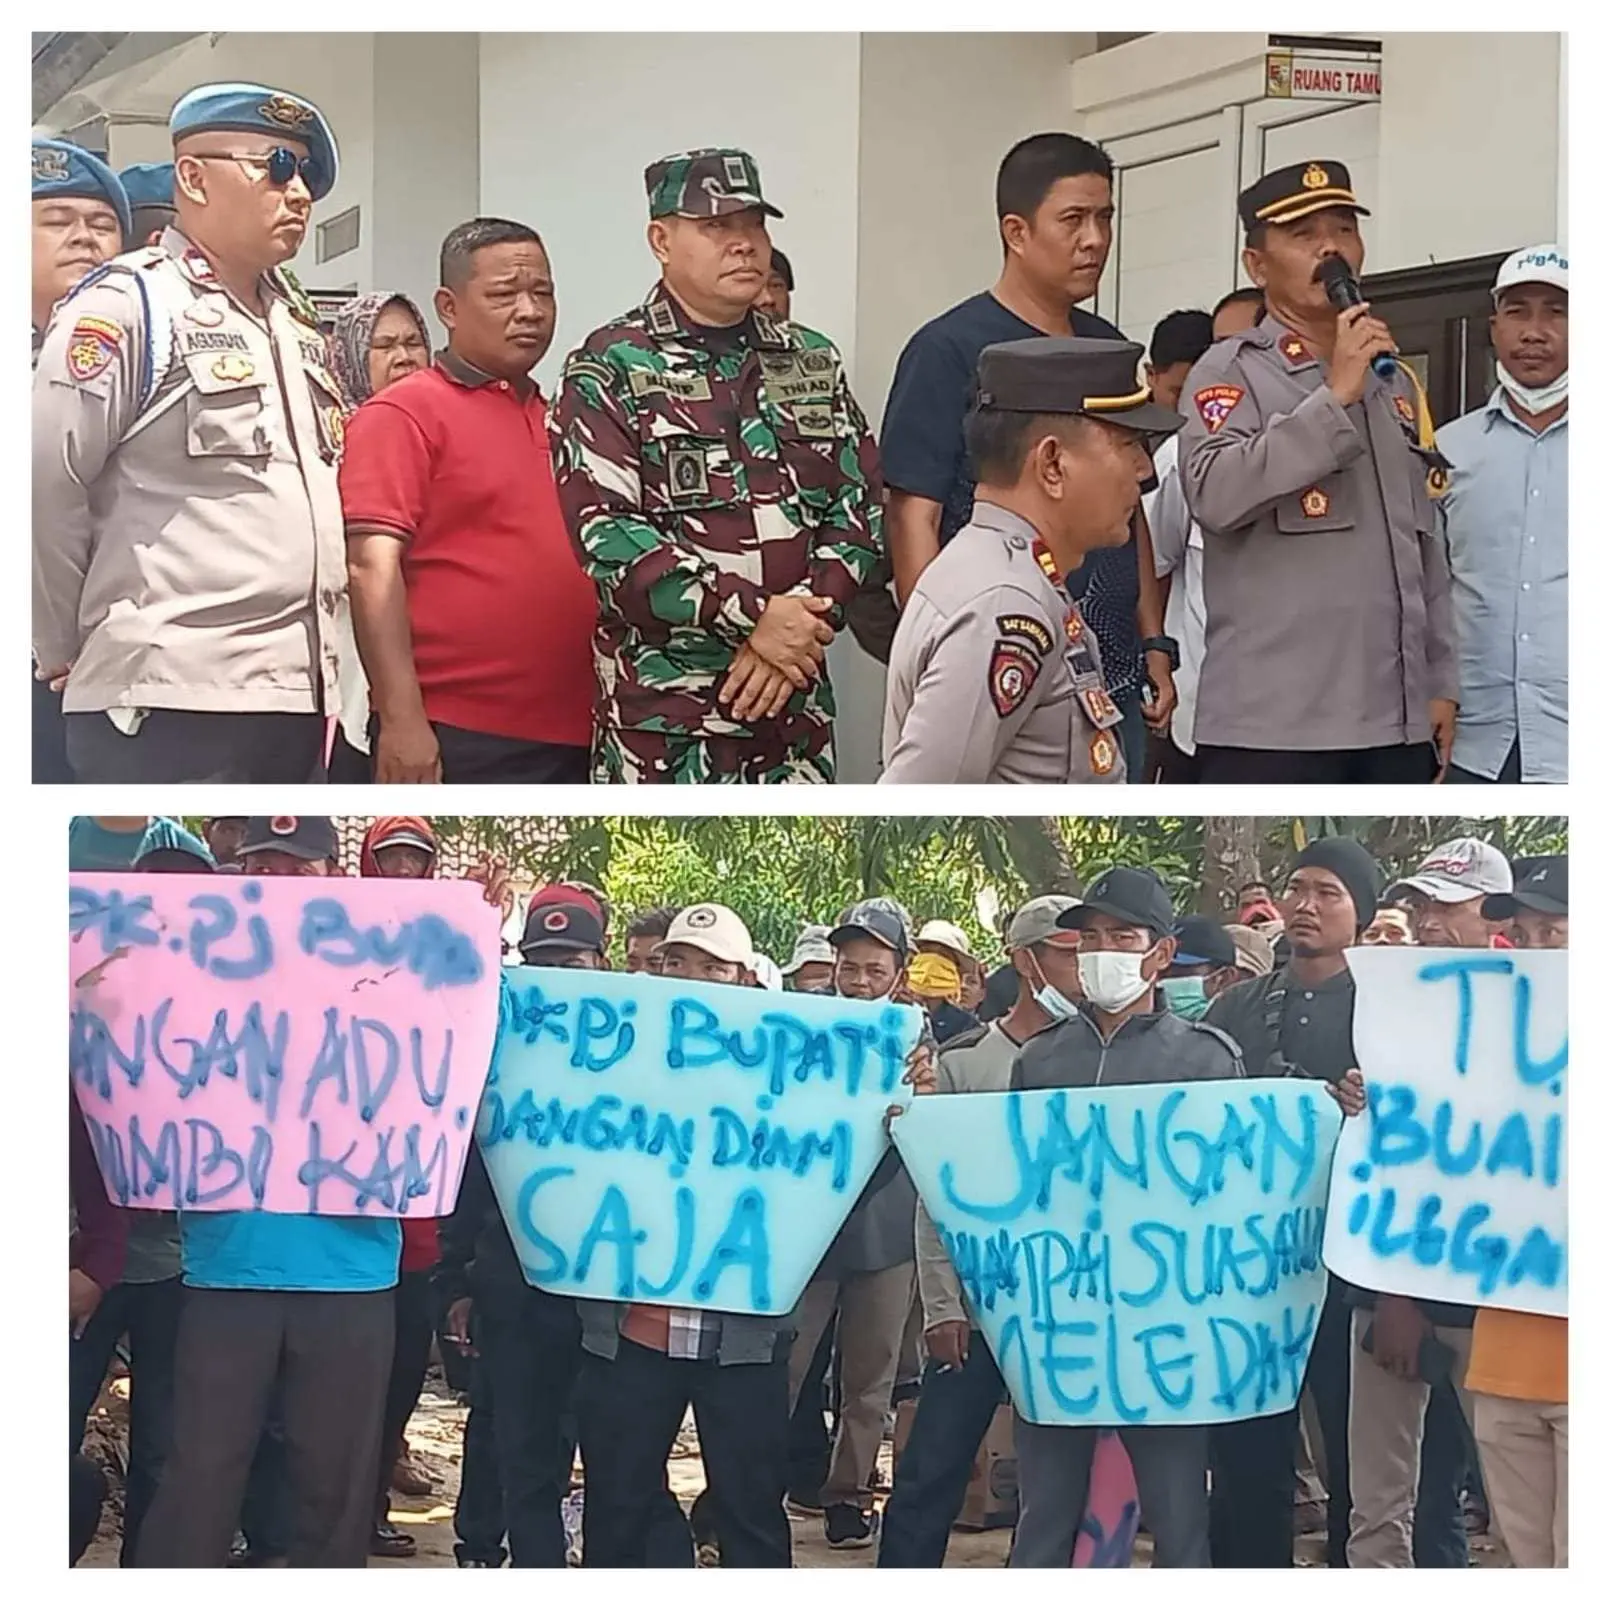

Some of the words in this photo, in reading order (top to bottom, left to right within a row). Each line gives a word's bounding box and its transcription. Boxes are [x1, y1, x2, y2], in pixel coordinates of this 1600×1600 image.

[1294, 69, 1341, 93] RUANG
[1345, 72, 1381, 95] TAMU
[810, 380, 830, 392] AD
[300, 1005, 453, 1123] ADU
[939, 1088, 1318, 1222] JANGAN
